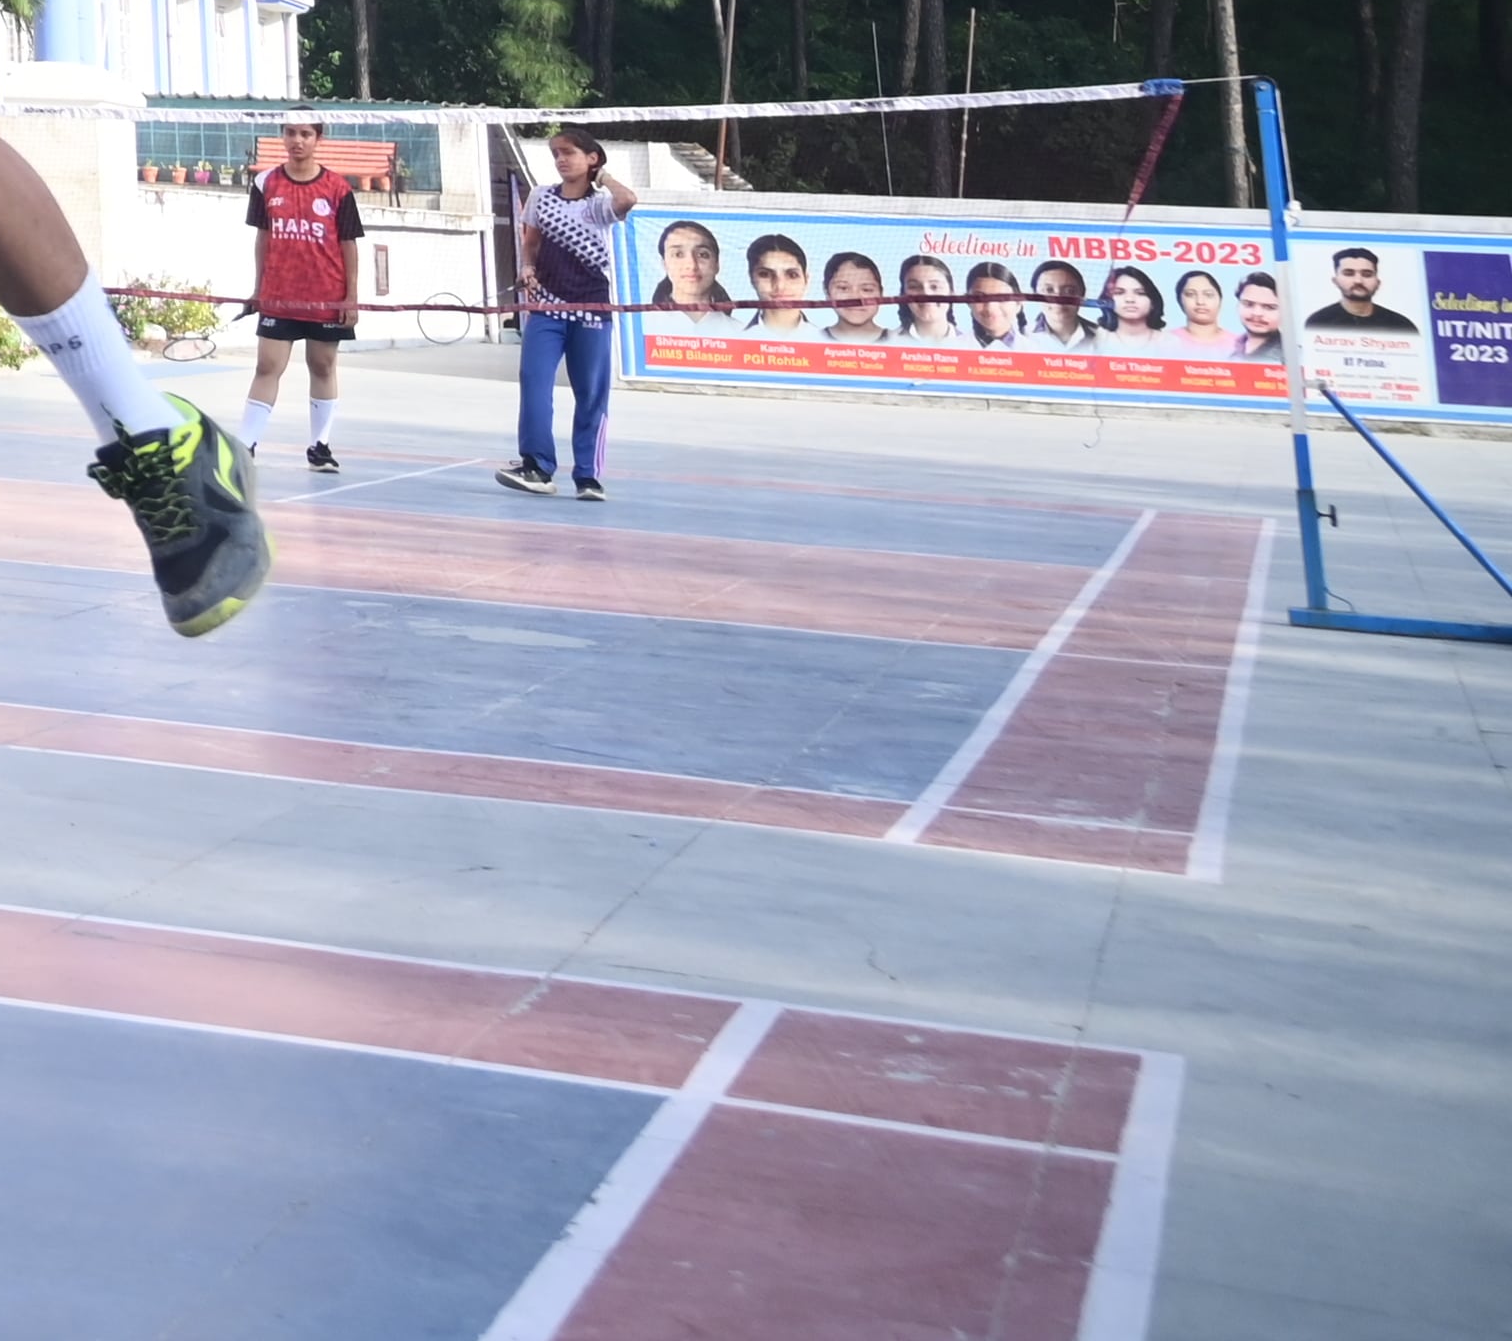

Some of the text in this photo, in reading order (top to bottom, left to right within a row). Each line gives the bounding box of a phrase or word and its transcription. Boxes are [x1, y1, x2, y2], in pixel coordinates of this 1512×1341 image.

[271, 217, 325, 238] HAPS
[919, 232, 1263, 267] Selections in MBBS-2023
[655, 336, 700, 349] Shivangi
[759, 344, 796, 355] Kanika
[1314, 334, 1411, 351] Aarav Shyam
[651, 348, 733, 363] AIIMS Bilaspur
[743, 353, 810, 367] PGI Rohtak
[901, 351, 959, 364] Arshia Rana
[1449, 343, 1510, 364] 2023
